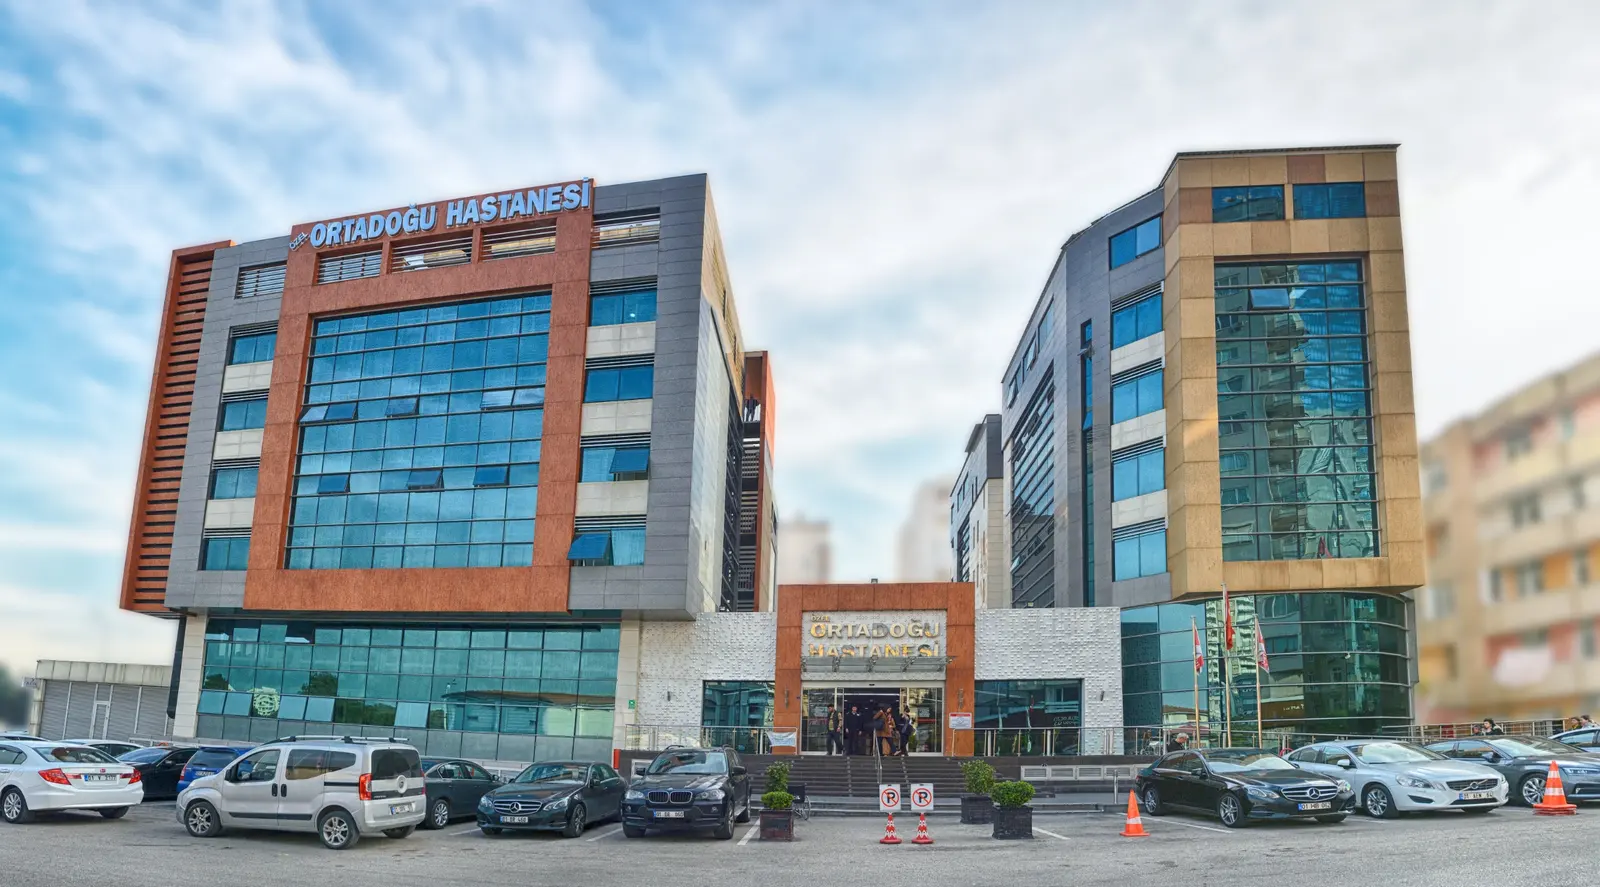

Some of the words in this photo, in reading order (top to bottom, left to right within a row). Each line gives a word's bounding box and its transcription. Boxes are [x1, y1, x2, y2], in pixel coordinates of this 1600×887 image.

[309, 202, 437, 249] ORTADOĞU
[446, 177, 591, 229] HASTANESİ
[810, 618, 940, 639] ORTADOĞU
[808, 641, 940, 657] HASTANESİ
